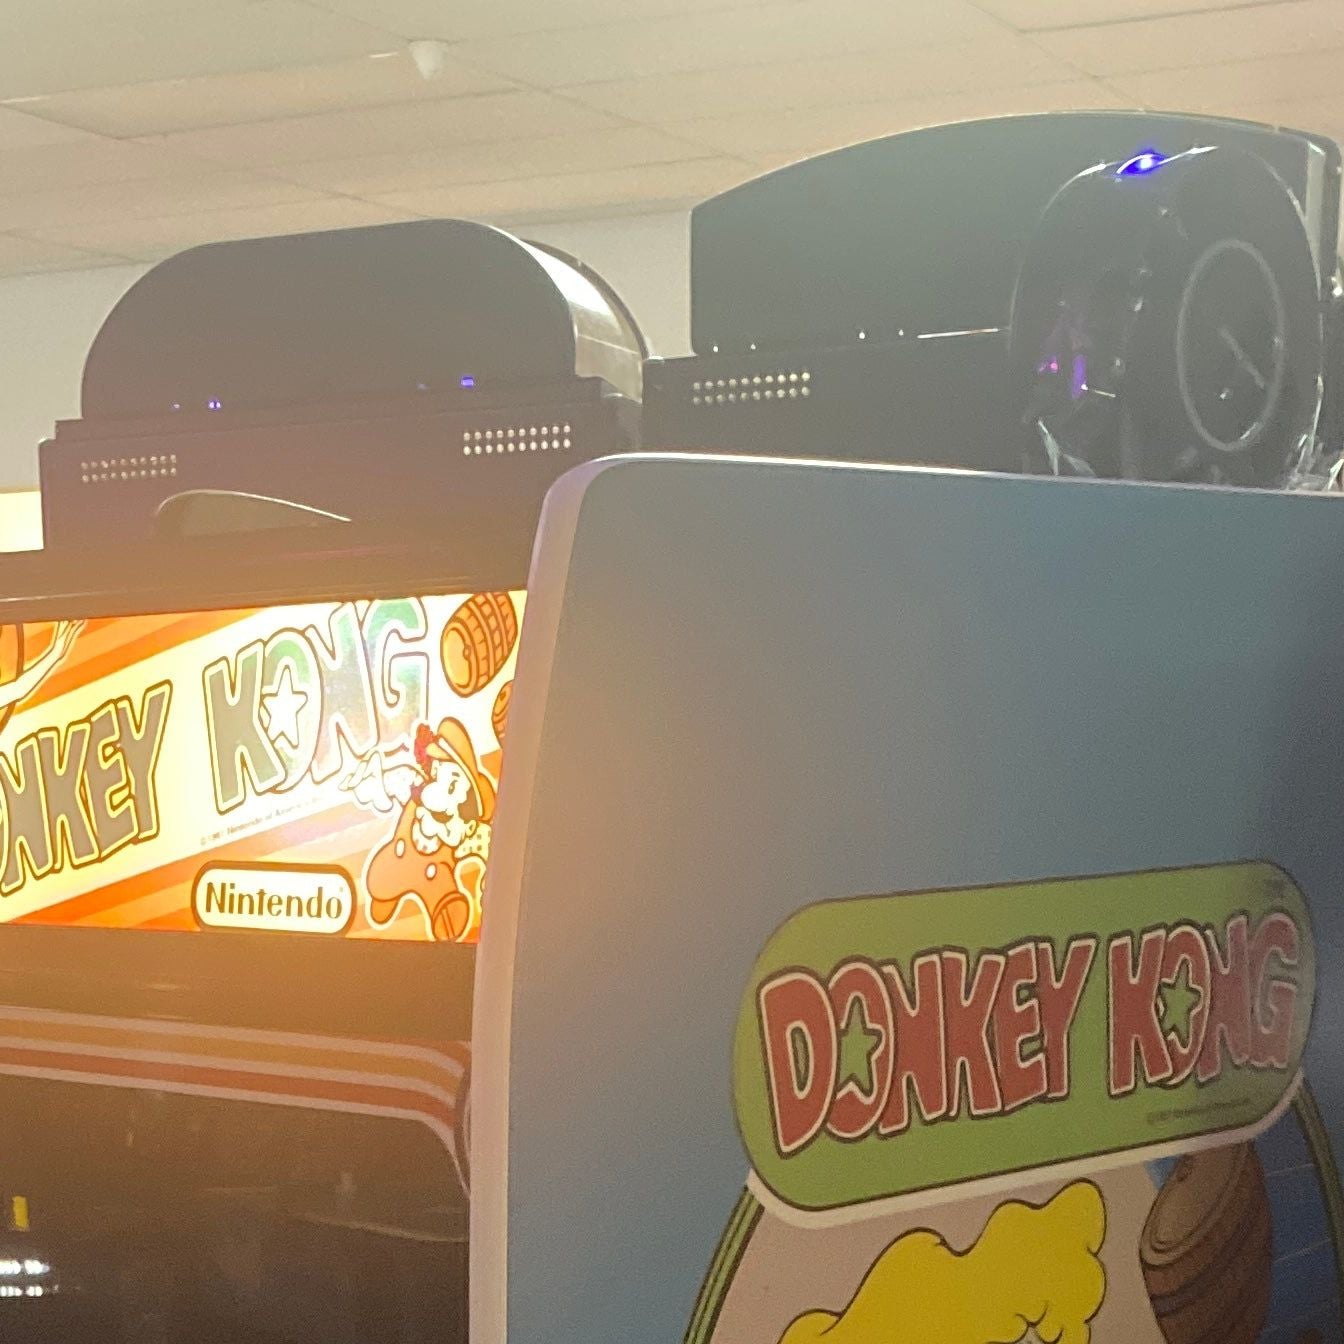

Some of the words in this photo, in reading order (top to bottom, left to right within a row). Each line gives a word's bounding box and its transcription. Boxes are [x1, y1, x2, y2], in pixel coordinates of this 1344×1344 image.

[204, 597, 429, 816] KONG
[205, 881, 343, 919] Nintendo
[757, 934, 1098, 1159] DONKEY
[1108, 908, 1301, 1097] KONG
